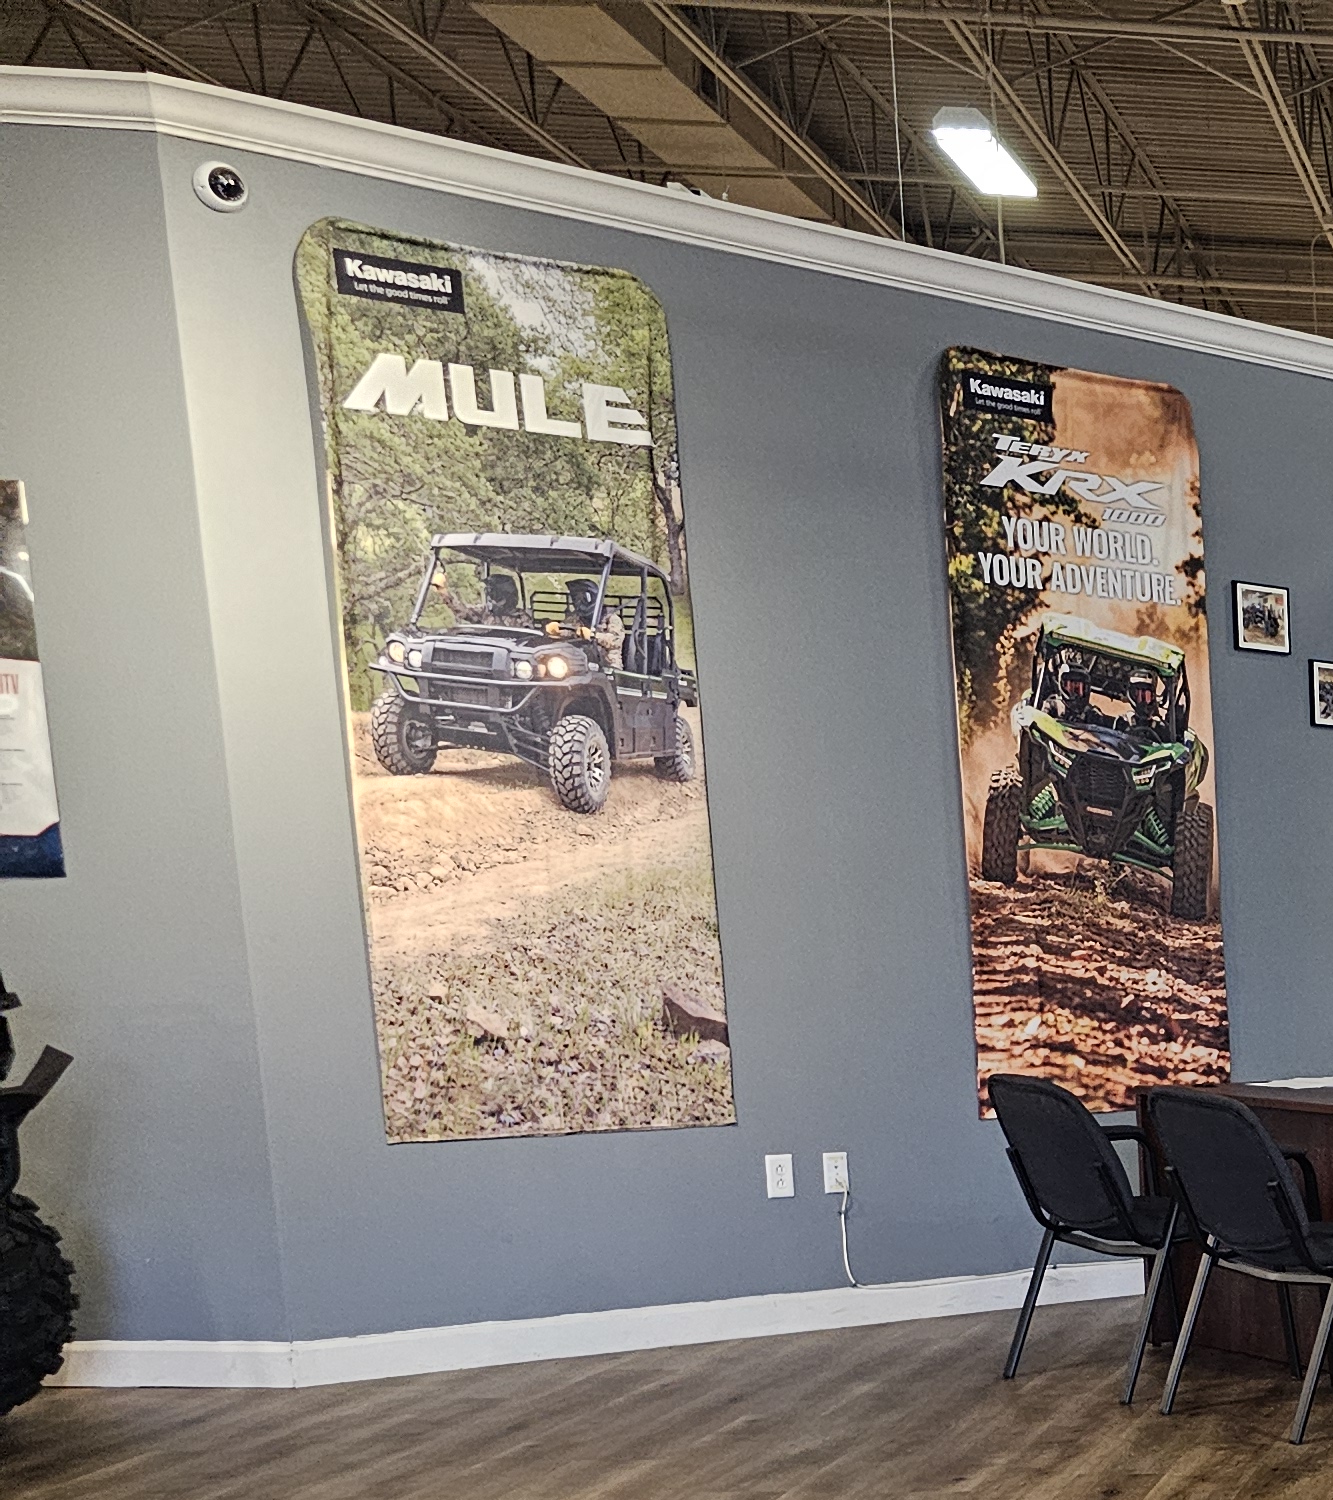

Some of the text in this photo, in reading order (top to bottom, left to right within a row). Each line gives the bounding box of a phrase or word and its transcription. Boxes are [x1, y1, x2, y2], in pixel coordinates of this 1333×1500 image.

[344, 257, 452, 294] Kawasaki
[370, 283, 384, 295] the
[385, 286, 408, 299] good
[409, 289, 432, 303] times
[343, 352, 652, 446] MULE
[969, 377, 1045, 406] Kawasaki
[979, 454, 1166, 511] KRX
[1102, 507, 1166, 527] 1000
[1001, 515, 1160, 567] YOUR WORLD.
[978, 551, 1182, 606] YOUR ADVENTURE.
